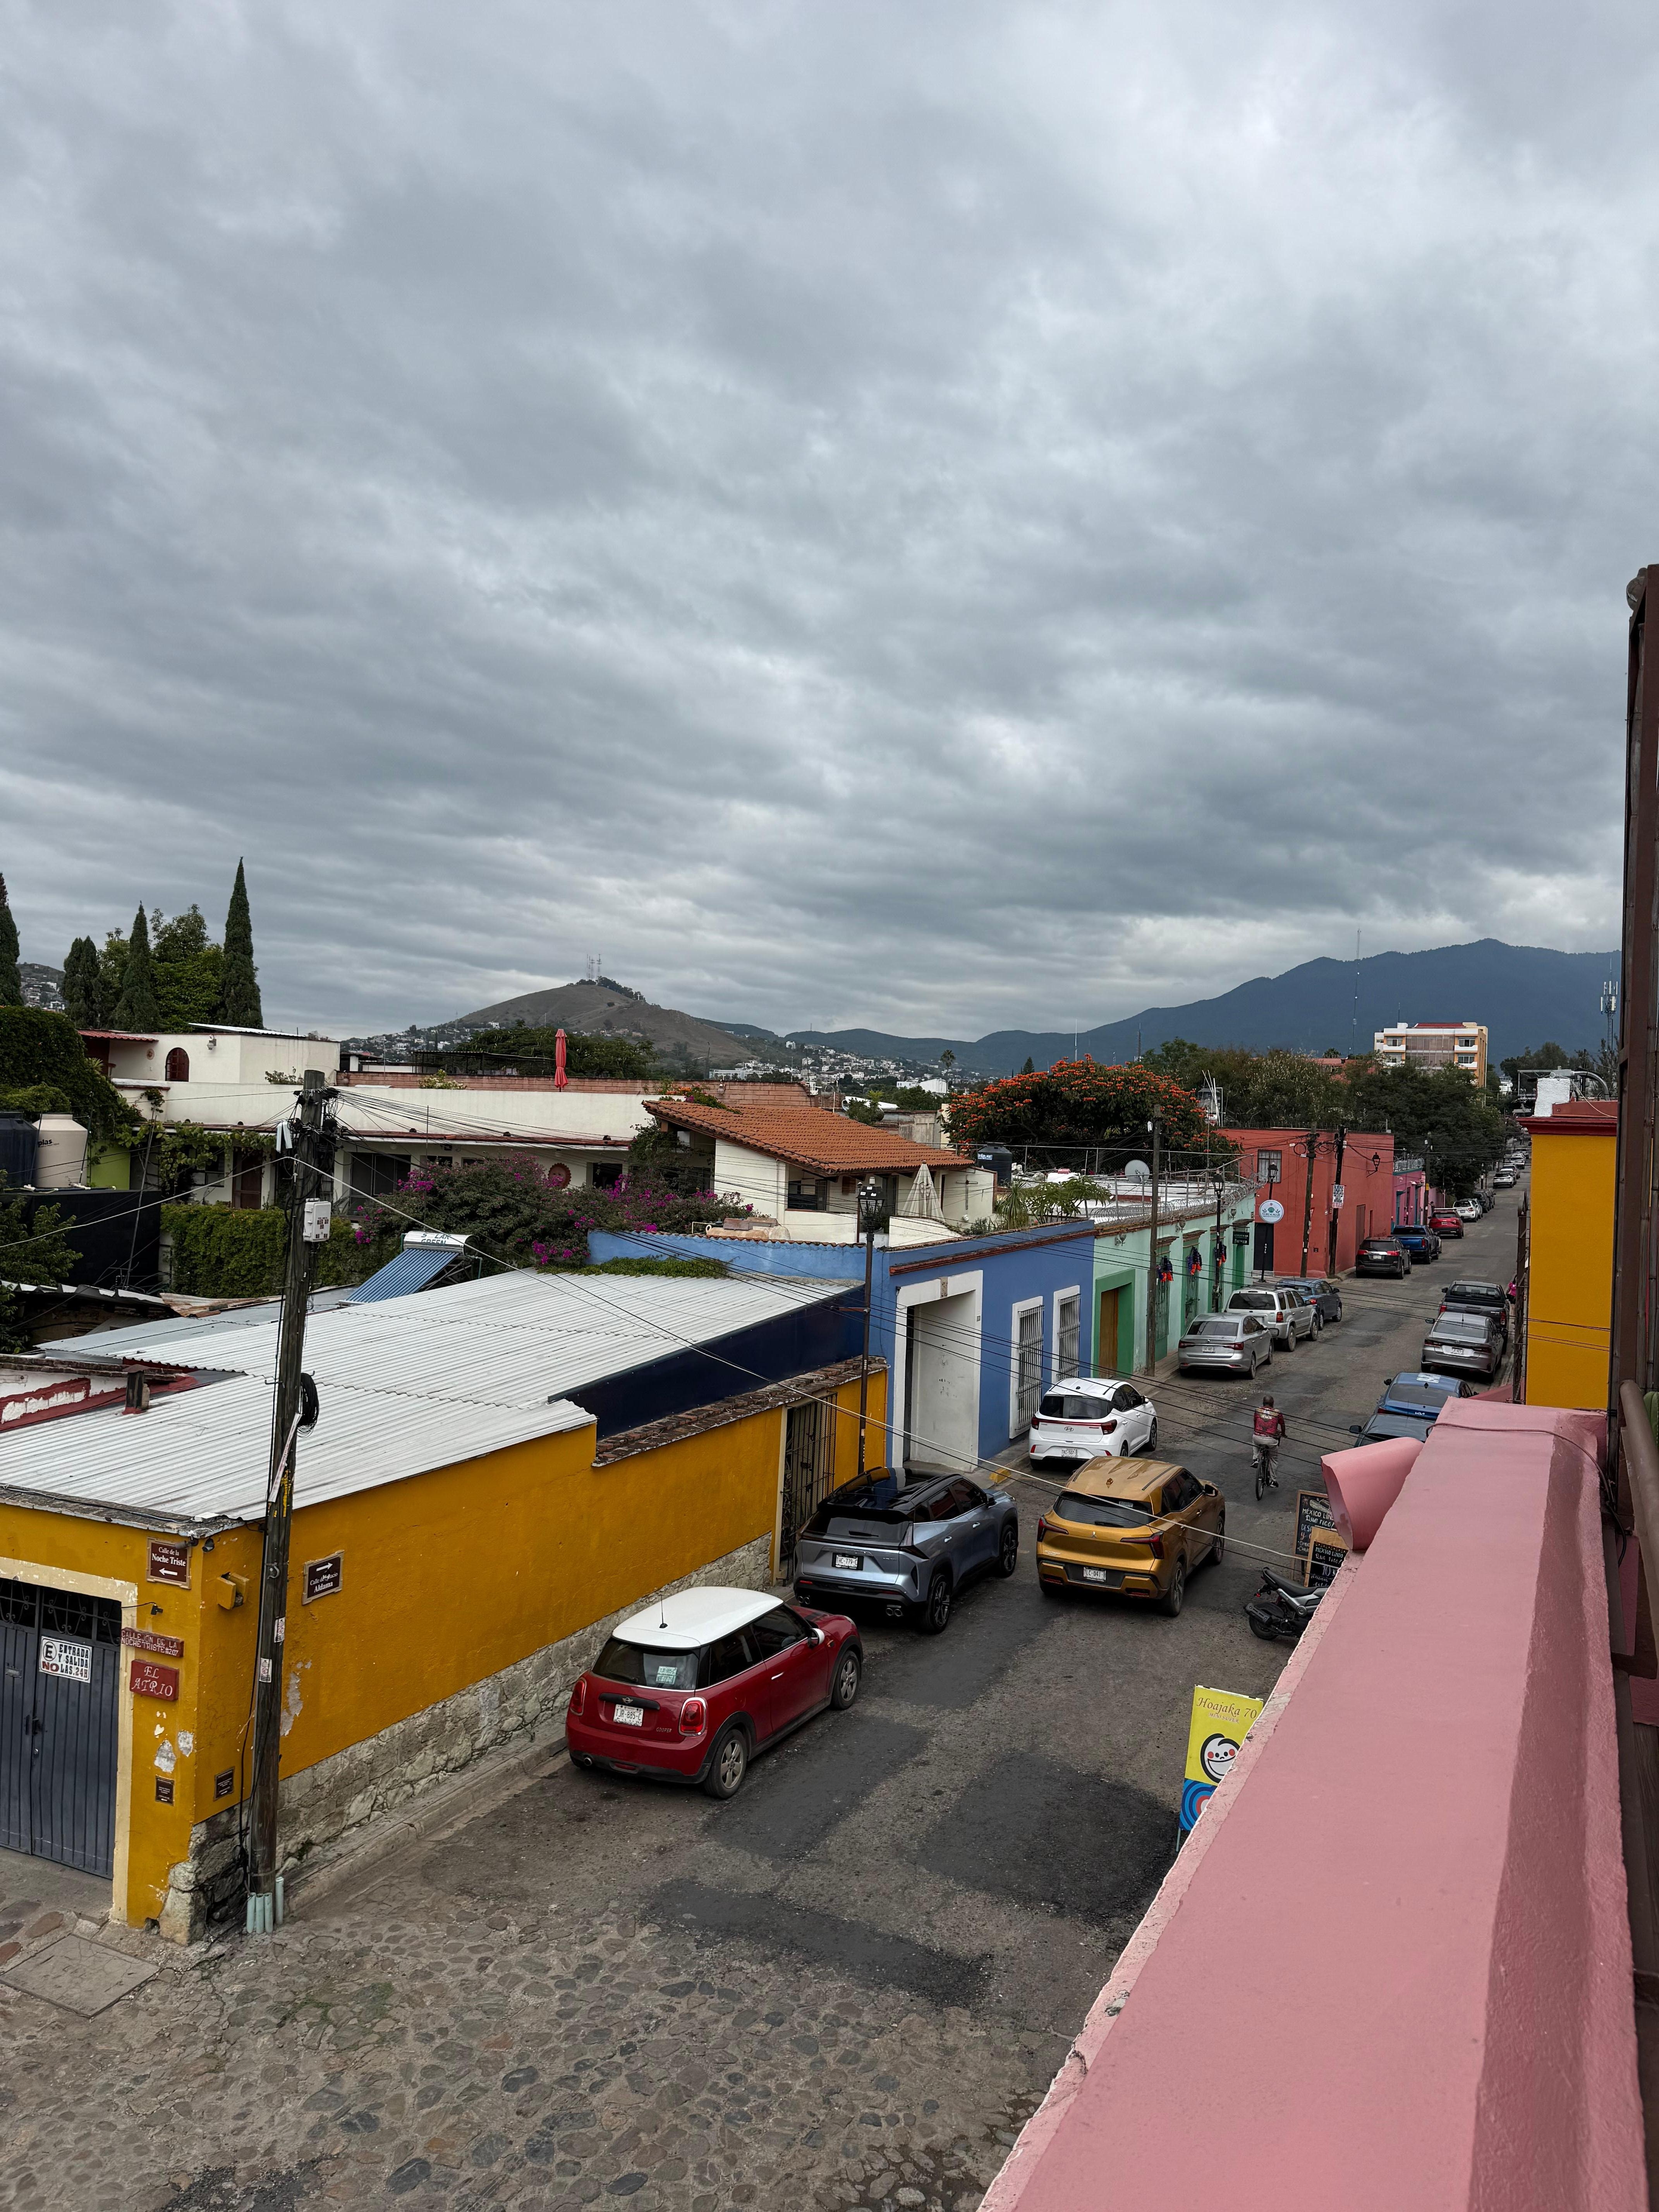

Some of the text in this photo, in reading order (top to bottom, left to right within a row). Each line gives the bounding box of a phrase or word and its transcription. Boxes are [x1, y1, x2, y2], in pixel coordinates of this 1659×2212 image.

[1302, 1508, 1321, 1517] MÉXICO
[152, 1553, 186, 1566] Noche Triste
[314, 1582, 333, 1593] Aldama
[121, 1630, 153, 1643] CALLEJON
[169, 1641, 177, 1649] LA
[59, 1644, 89, 1659] ENTRADA
[42, 1661, 59, 1672] NO
[58, 1654, 88, 1668] Y SALIDA
[144, 1666, 160, 1679] EL
[131, 1678, 173, 1696] ATRIO
[1197, 1697, 1257, 1719] Hoajaka 70
